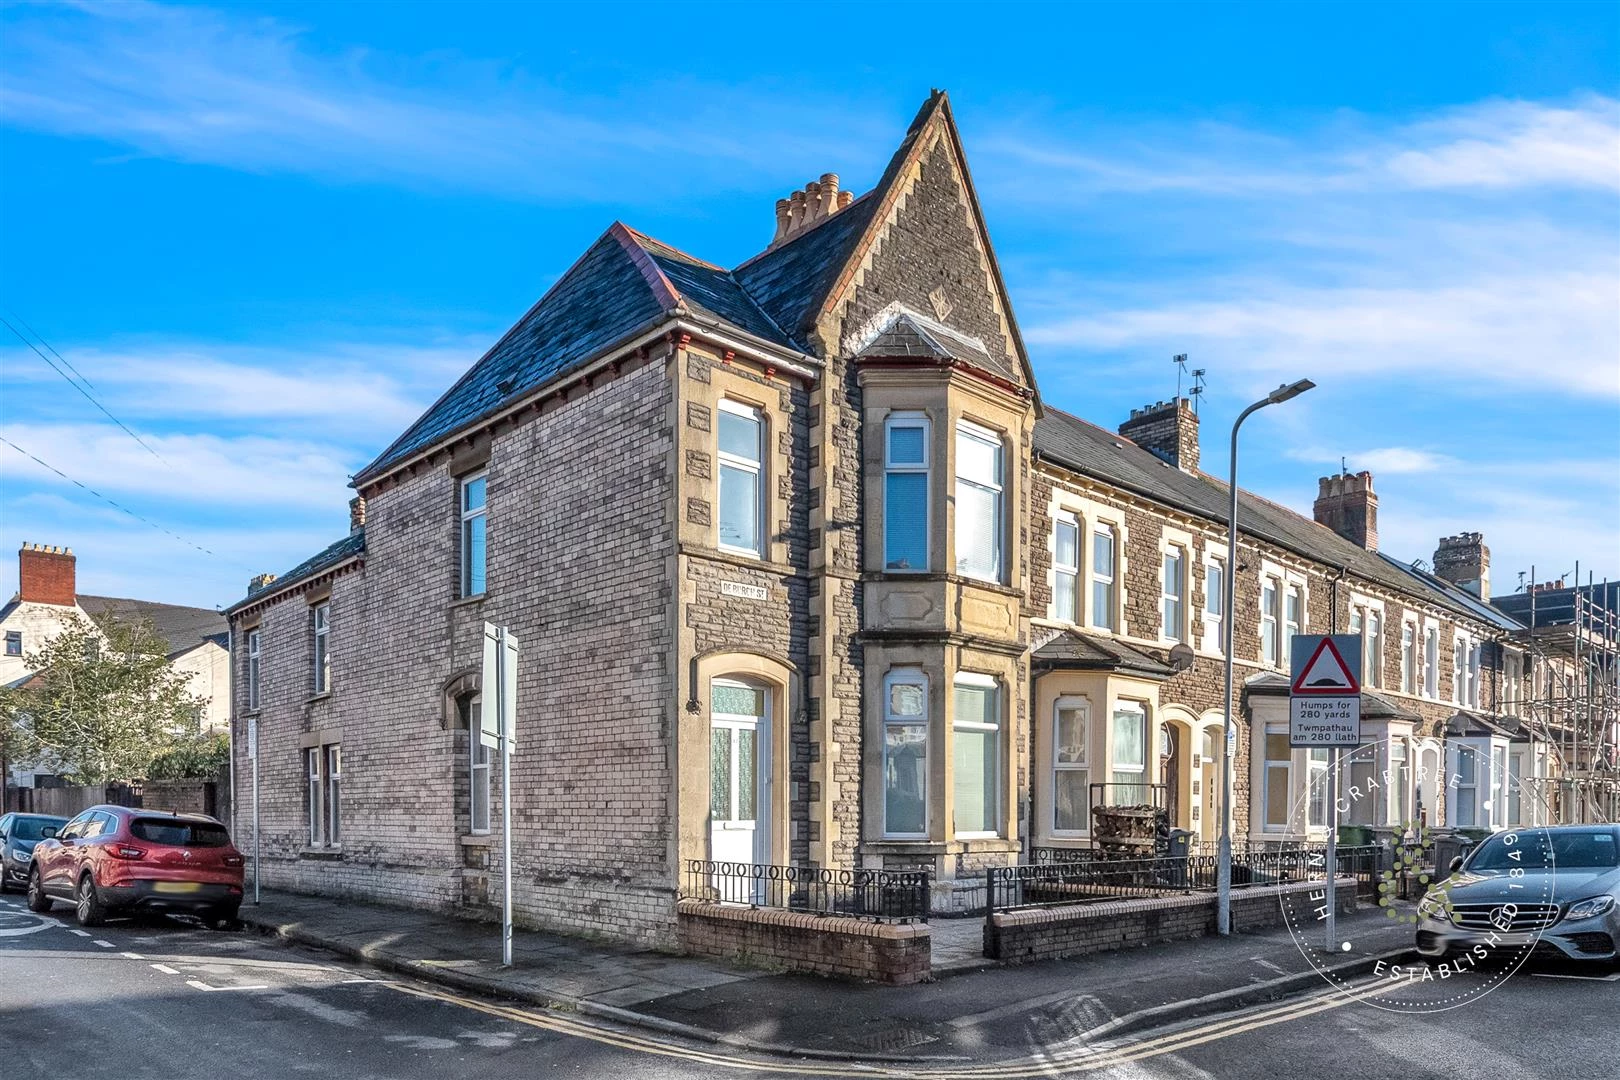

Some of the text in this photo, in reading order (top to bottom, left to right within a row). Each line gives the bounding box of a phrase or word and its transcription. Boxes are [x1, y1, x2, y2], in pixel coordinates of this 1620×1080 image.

[1300, 701, 1351, 710] Humps for
[1300, 710, 1351, 719] 280 yards
[1298, 724, 1353, 732] Twmpathau
[1310, 733, 1331, 741] 280
[1335, 733, 1357, 741] llath
